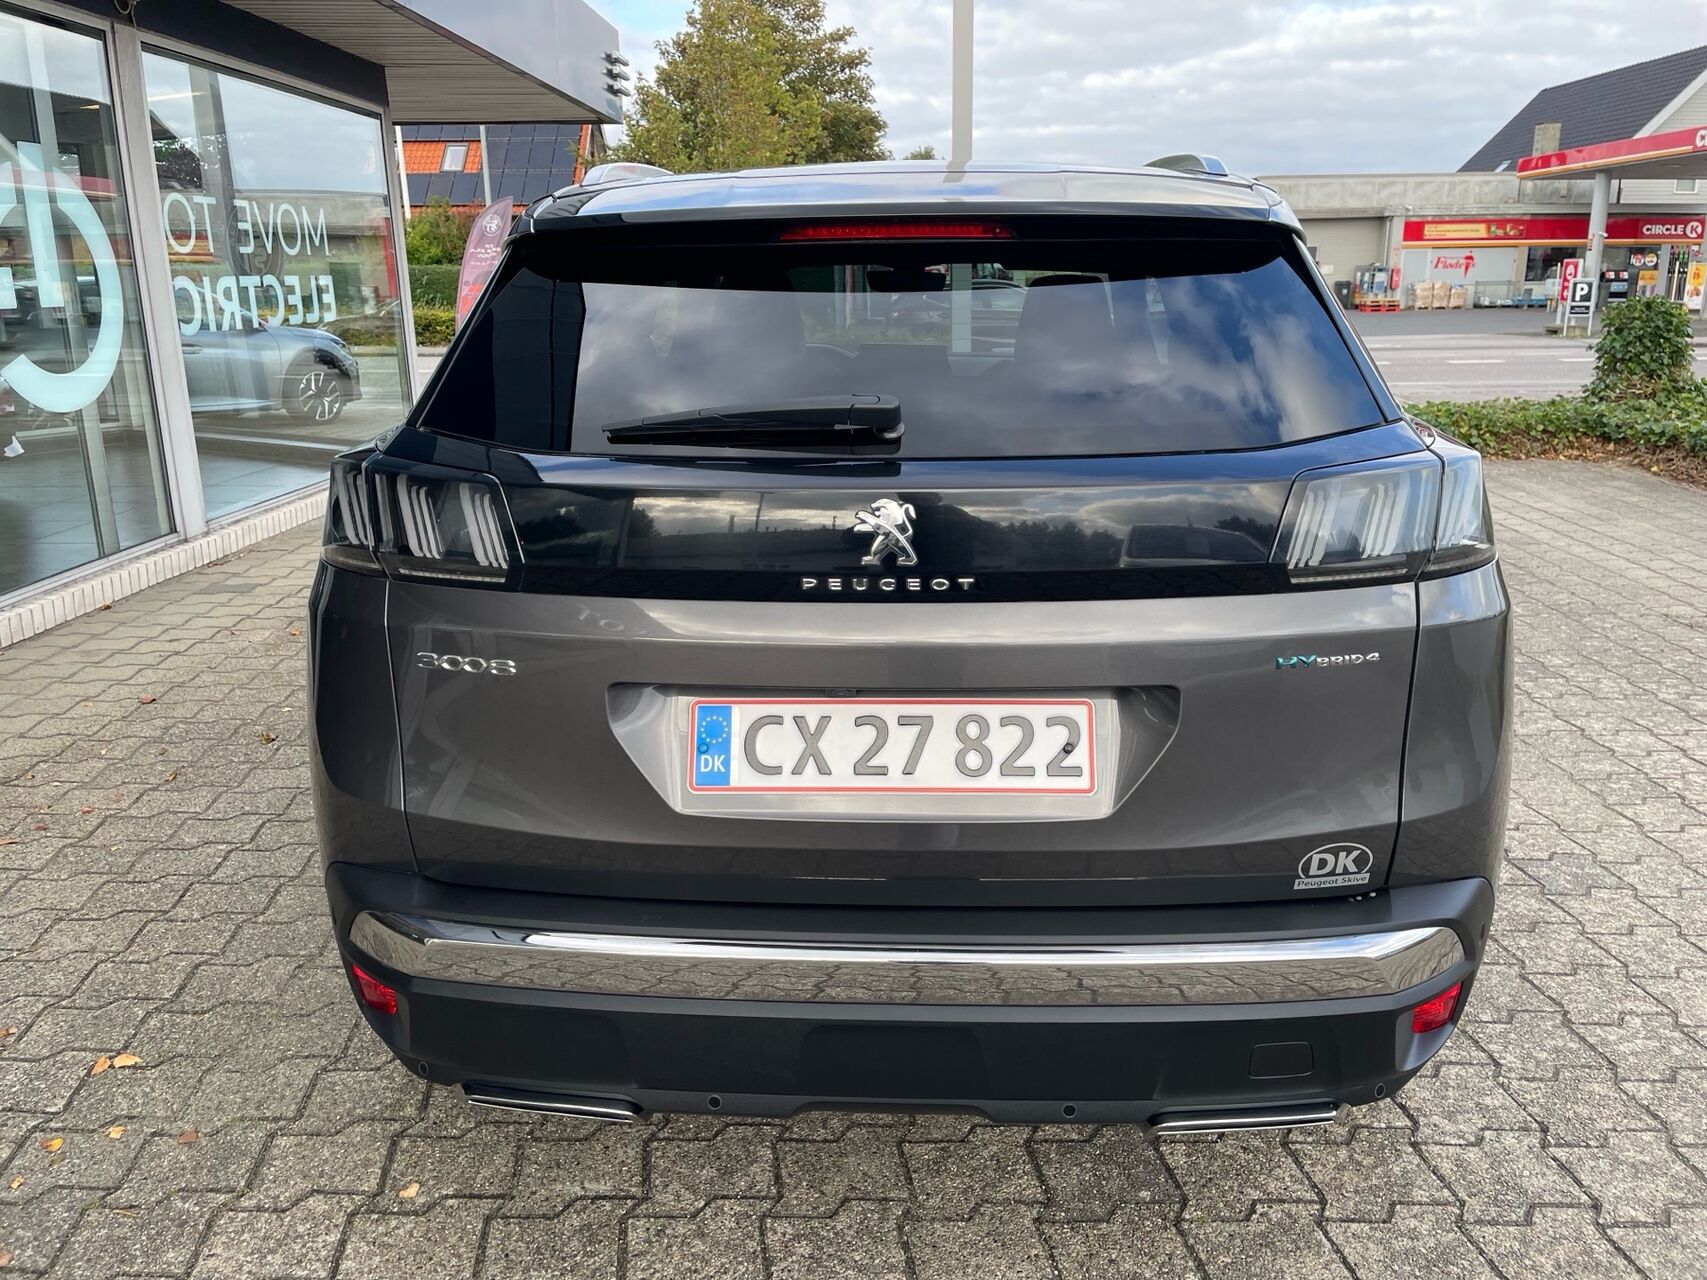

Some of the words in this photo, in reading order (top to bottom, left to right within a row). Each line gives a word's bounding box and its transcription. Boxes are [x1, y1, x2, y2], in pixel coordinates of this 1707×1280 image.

[1642, 223, 1685, 236] CIRCLE
[1686, 222, 1702, 238] K
[1575, 283, 1589, 302] P
[802, 578, 975, 591] PEUGEOT
[416, 651, 517, 676] 3008
[1276, 652, 1380, 670] HYBRID4
[743, 714, 832, 776] CX
[853, 714, 934, 776] 27
[955, 713, 1083, 778] 822
[700, 754, 726, 773] DK
[1308, 849, 1362, 876] DK
[1297, 877, 1339, 888] Peugeot
[1341, 875, 1367, 884] Skive
